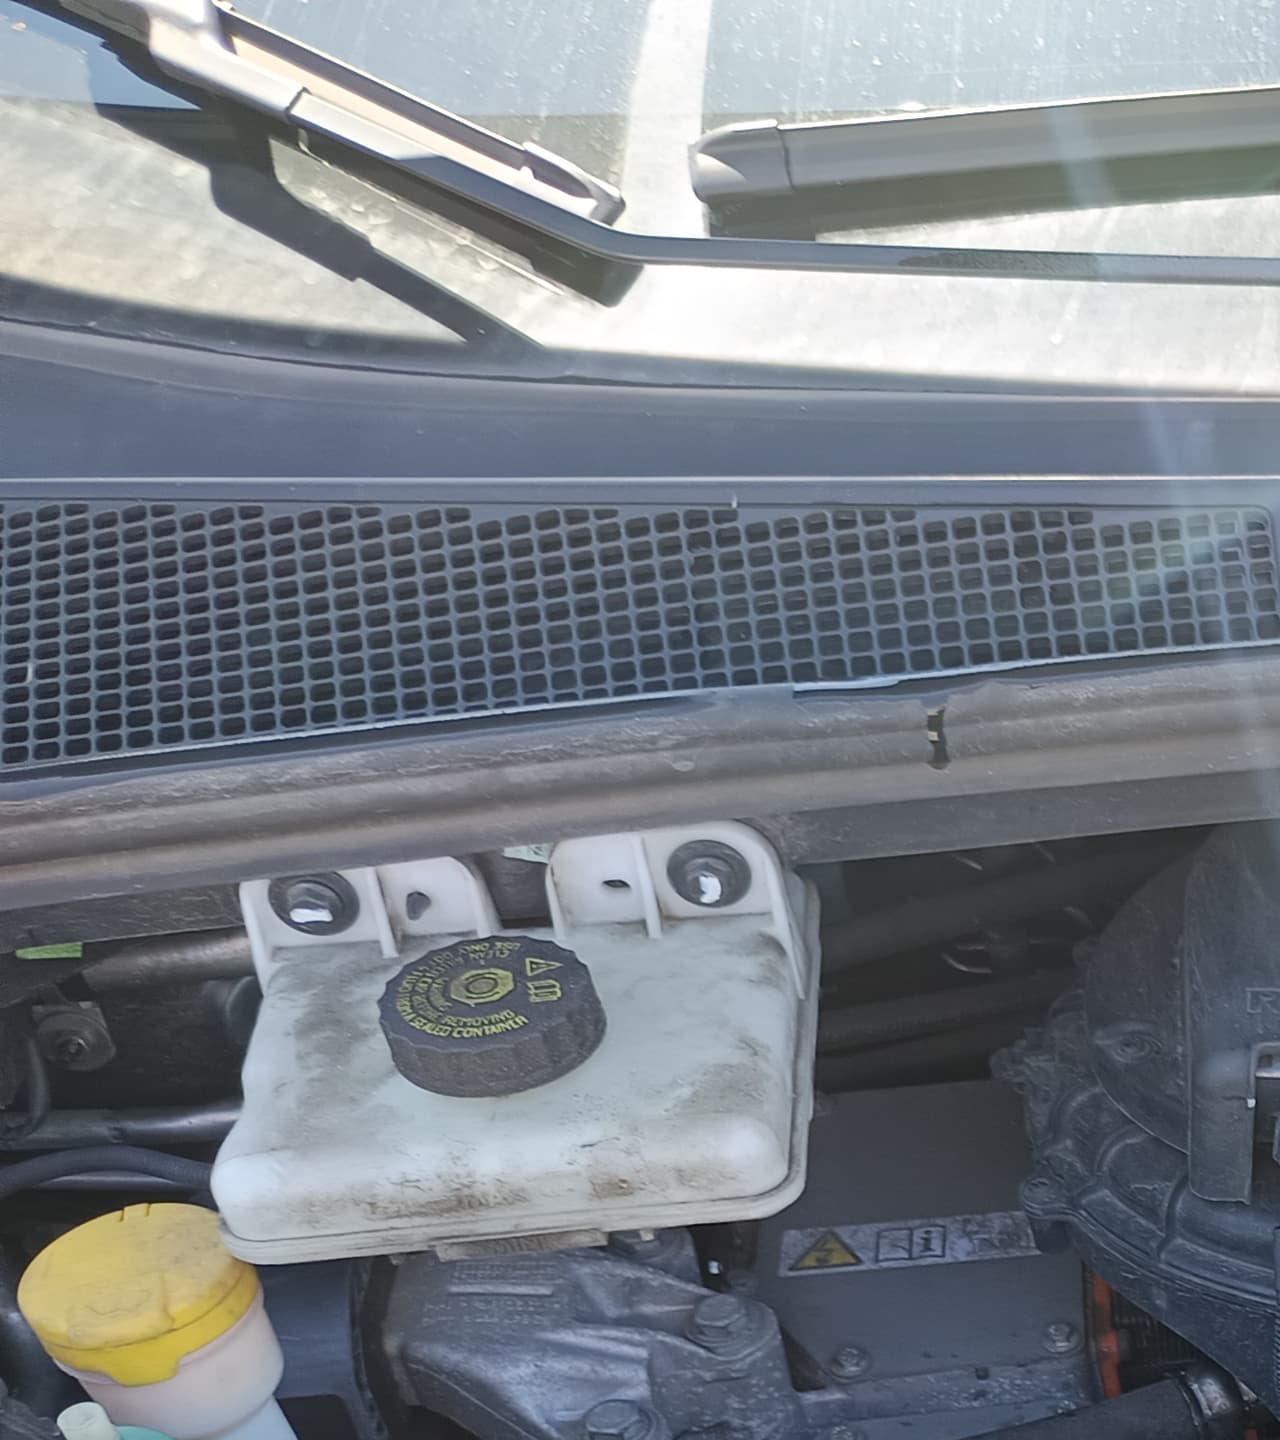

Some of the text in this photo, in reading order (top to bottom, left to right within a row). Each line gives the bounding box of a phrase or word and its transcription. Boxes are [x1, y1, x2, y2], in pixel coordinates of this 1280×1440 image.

[409, 1017, 452, 1037] SEALED
[451, 1015, 529, 1038] CONTAINER
[441, 1009, 515, 1026] REMOVING
